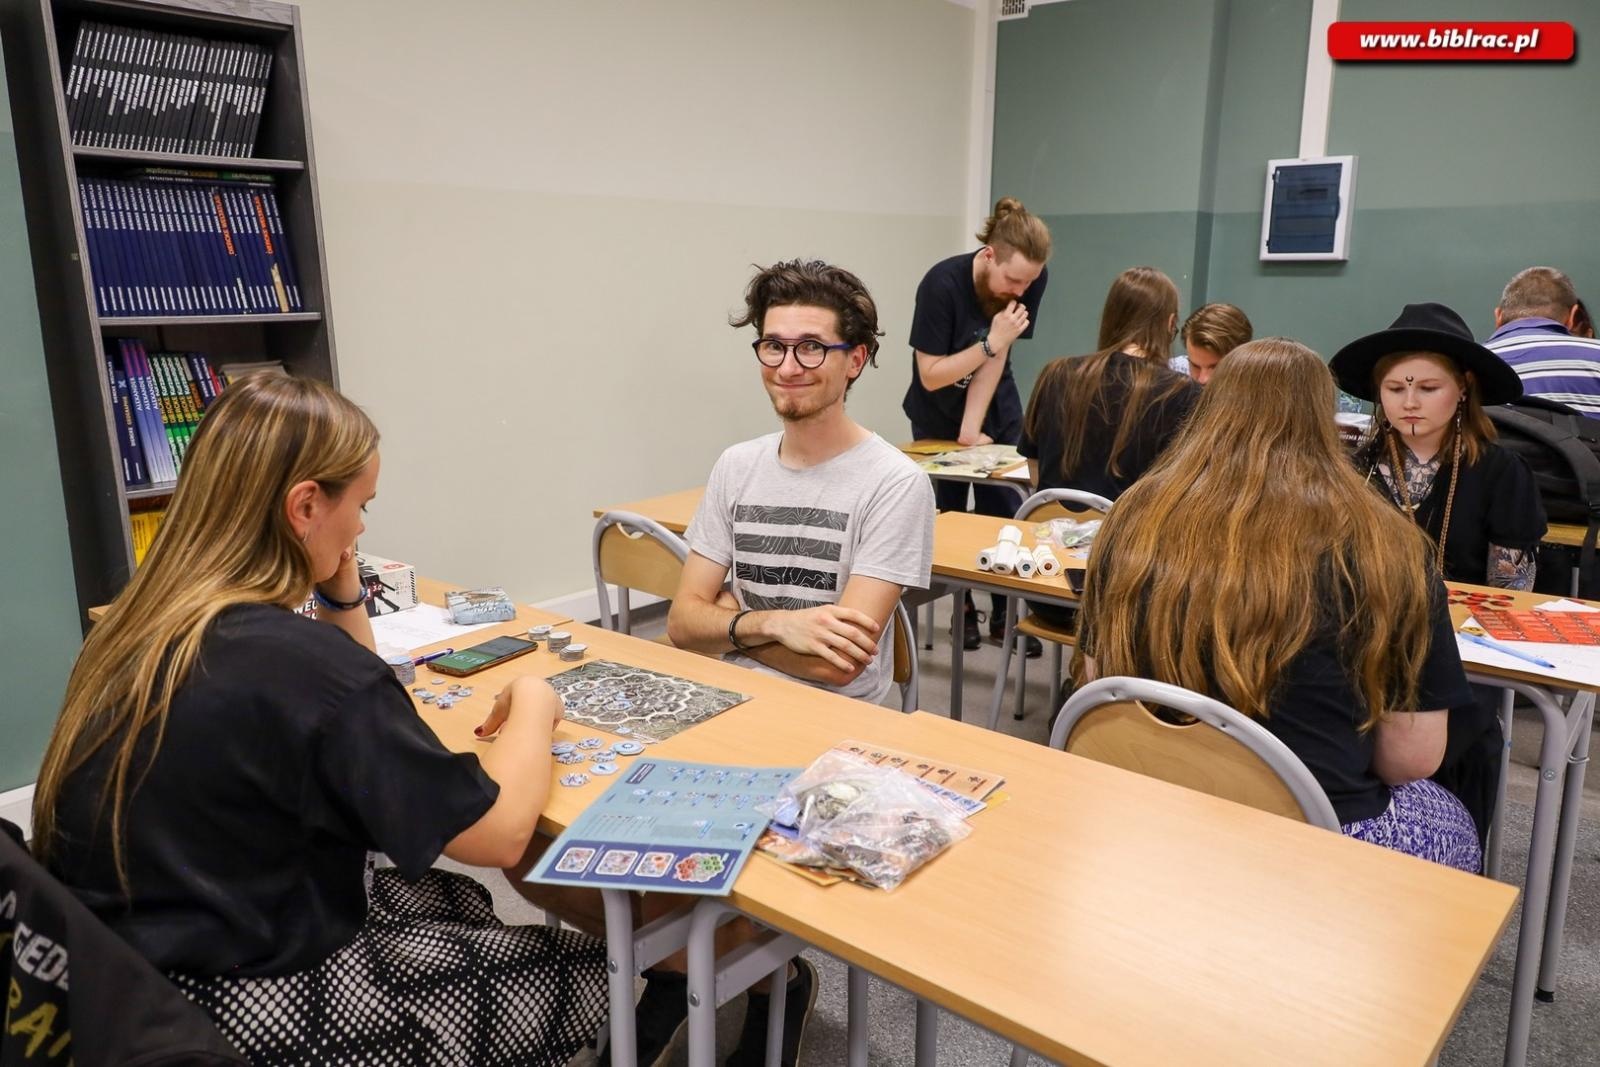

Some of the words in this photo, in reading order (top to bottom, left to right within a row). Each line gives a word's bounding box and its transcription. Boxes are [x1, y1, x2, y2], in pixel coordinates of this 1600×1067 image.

[130, 377, 142, 411] ALEXANDER
[138, 376, 151, 411] ALEXANDER
[146, 376, 159, 410] ALEXANDER
